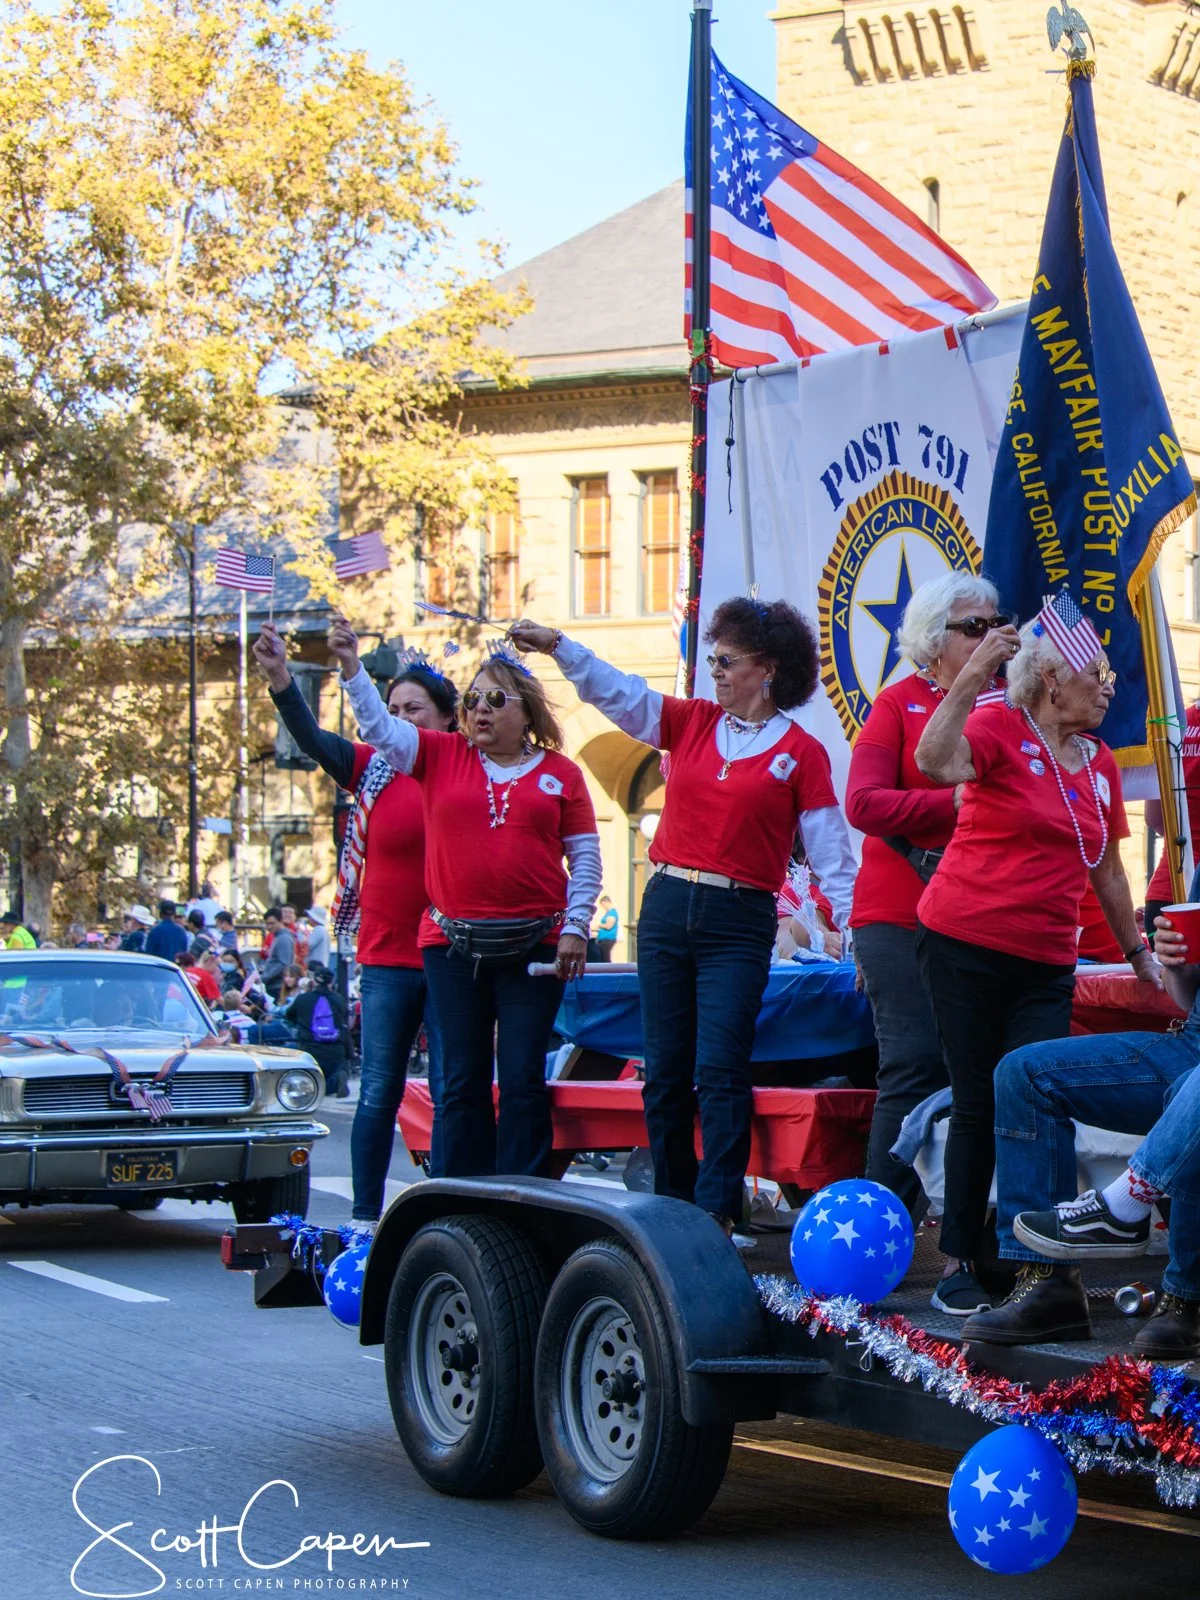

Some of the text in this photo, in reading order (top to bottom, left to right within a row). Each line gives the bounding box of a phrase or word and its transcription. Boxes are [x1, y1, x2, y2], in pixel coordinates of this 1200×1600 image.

[1031, 305, 1104, 453] MAYFAIR
[820, 421, 901, 512] POST
[918, 423, 970, 494] 791
[1011, 432, 1070, 583] CALIFORNIA
[834, 502, 914, 630] AMERICAN
[111, 1162, 174, 1182] SUF 225
